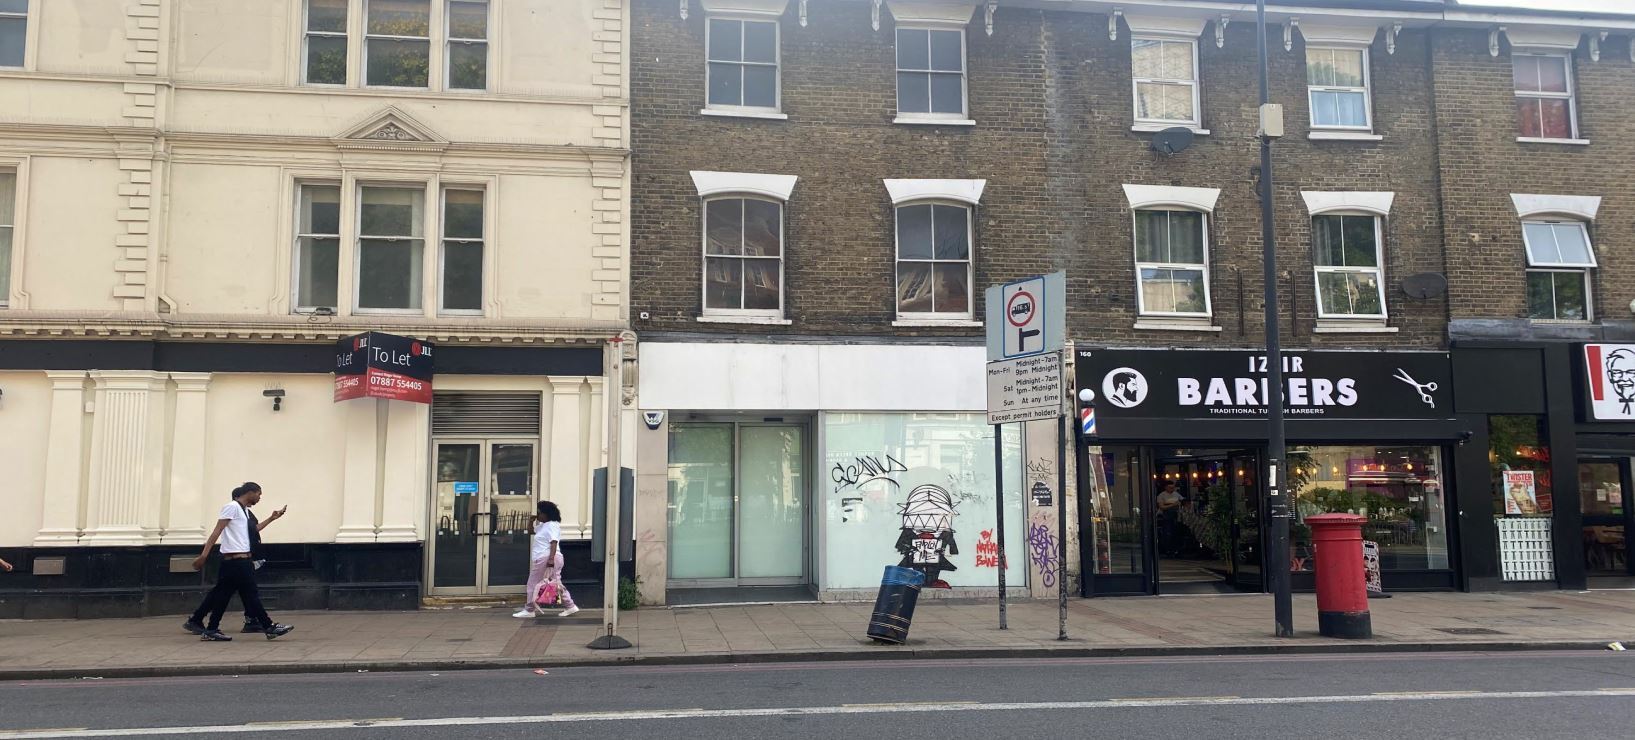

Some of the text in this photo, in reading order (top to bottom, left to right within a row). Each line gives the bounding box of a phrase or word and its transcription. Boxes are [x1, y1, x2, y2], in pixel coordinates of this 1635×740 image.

[373, 347, 411, 367] To Let
[421, 346, 432, 356] JLL
[342, 352, 353, 366] Let
[1248, 356, 1304, 373] IZIR
[1015, 364, 1058, 376] 9pm Midnight
[371, 376, 394, 387] 07887
[396, 380, 422, 392] 554405
[1003, 399, 1015, 407] Sun
[1021, 393, 1059, 405] At any time
[991, 409, 1057, 422] Except permit holders
[1507, 473, 1533, 481] TWISTER
[980, 528, 993, 542] BY
[976, 540, 1000, 556] NATHA
